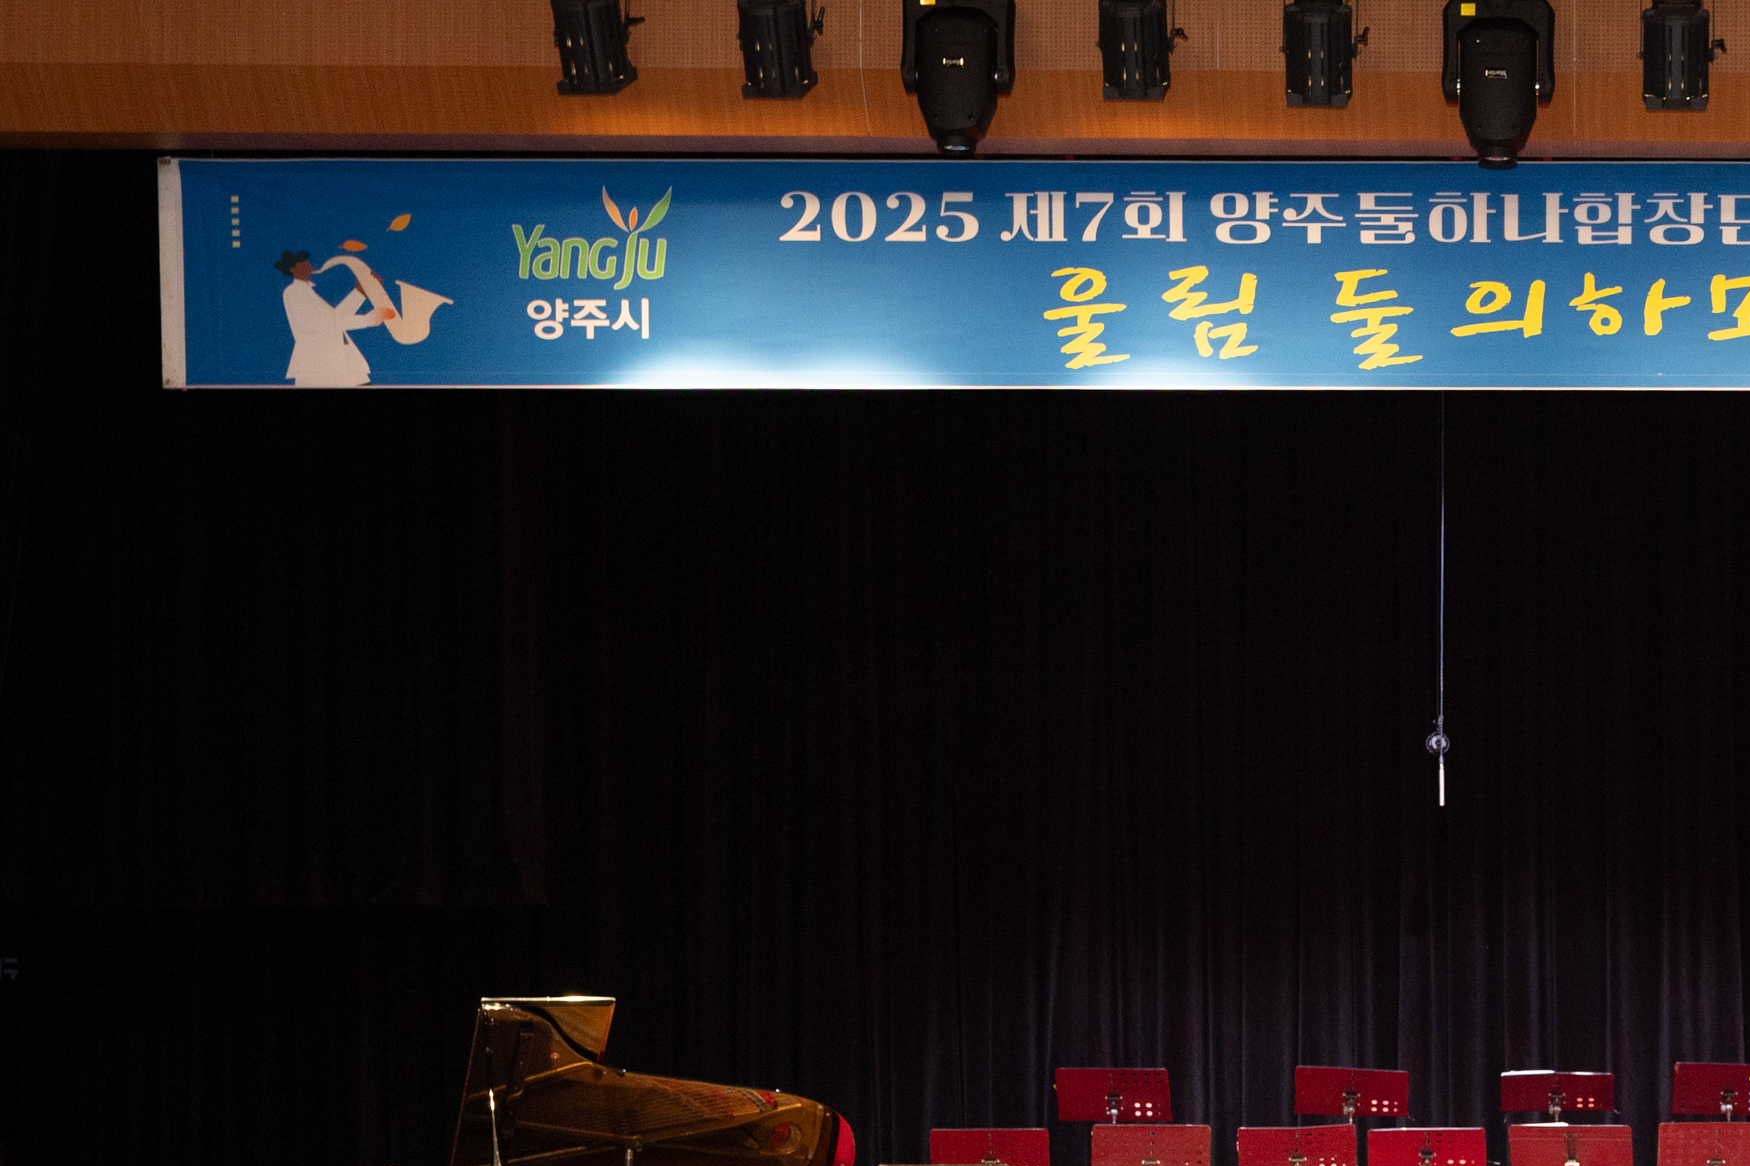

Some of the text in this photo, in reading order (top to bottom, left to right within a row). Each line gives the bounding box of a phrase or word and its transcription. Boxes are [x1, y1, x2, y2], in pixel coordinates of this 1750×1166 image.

[779, 191, 980, 242] 2025
[1002, 191, 1187, 242] 제7회
[527, 298, 649, 340] 양주시
